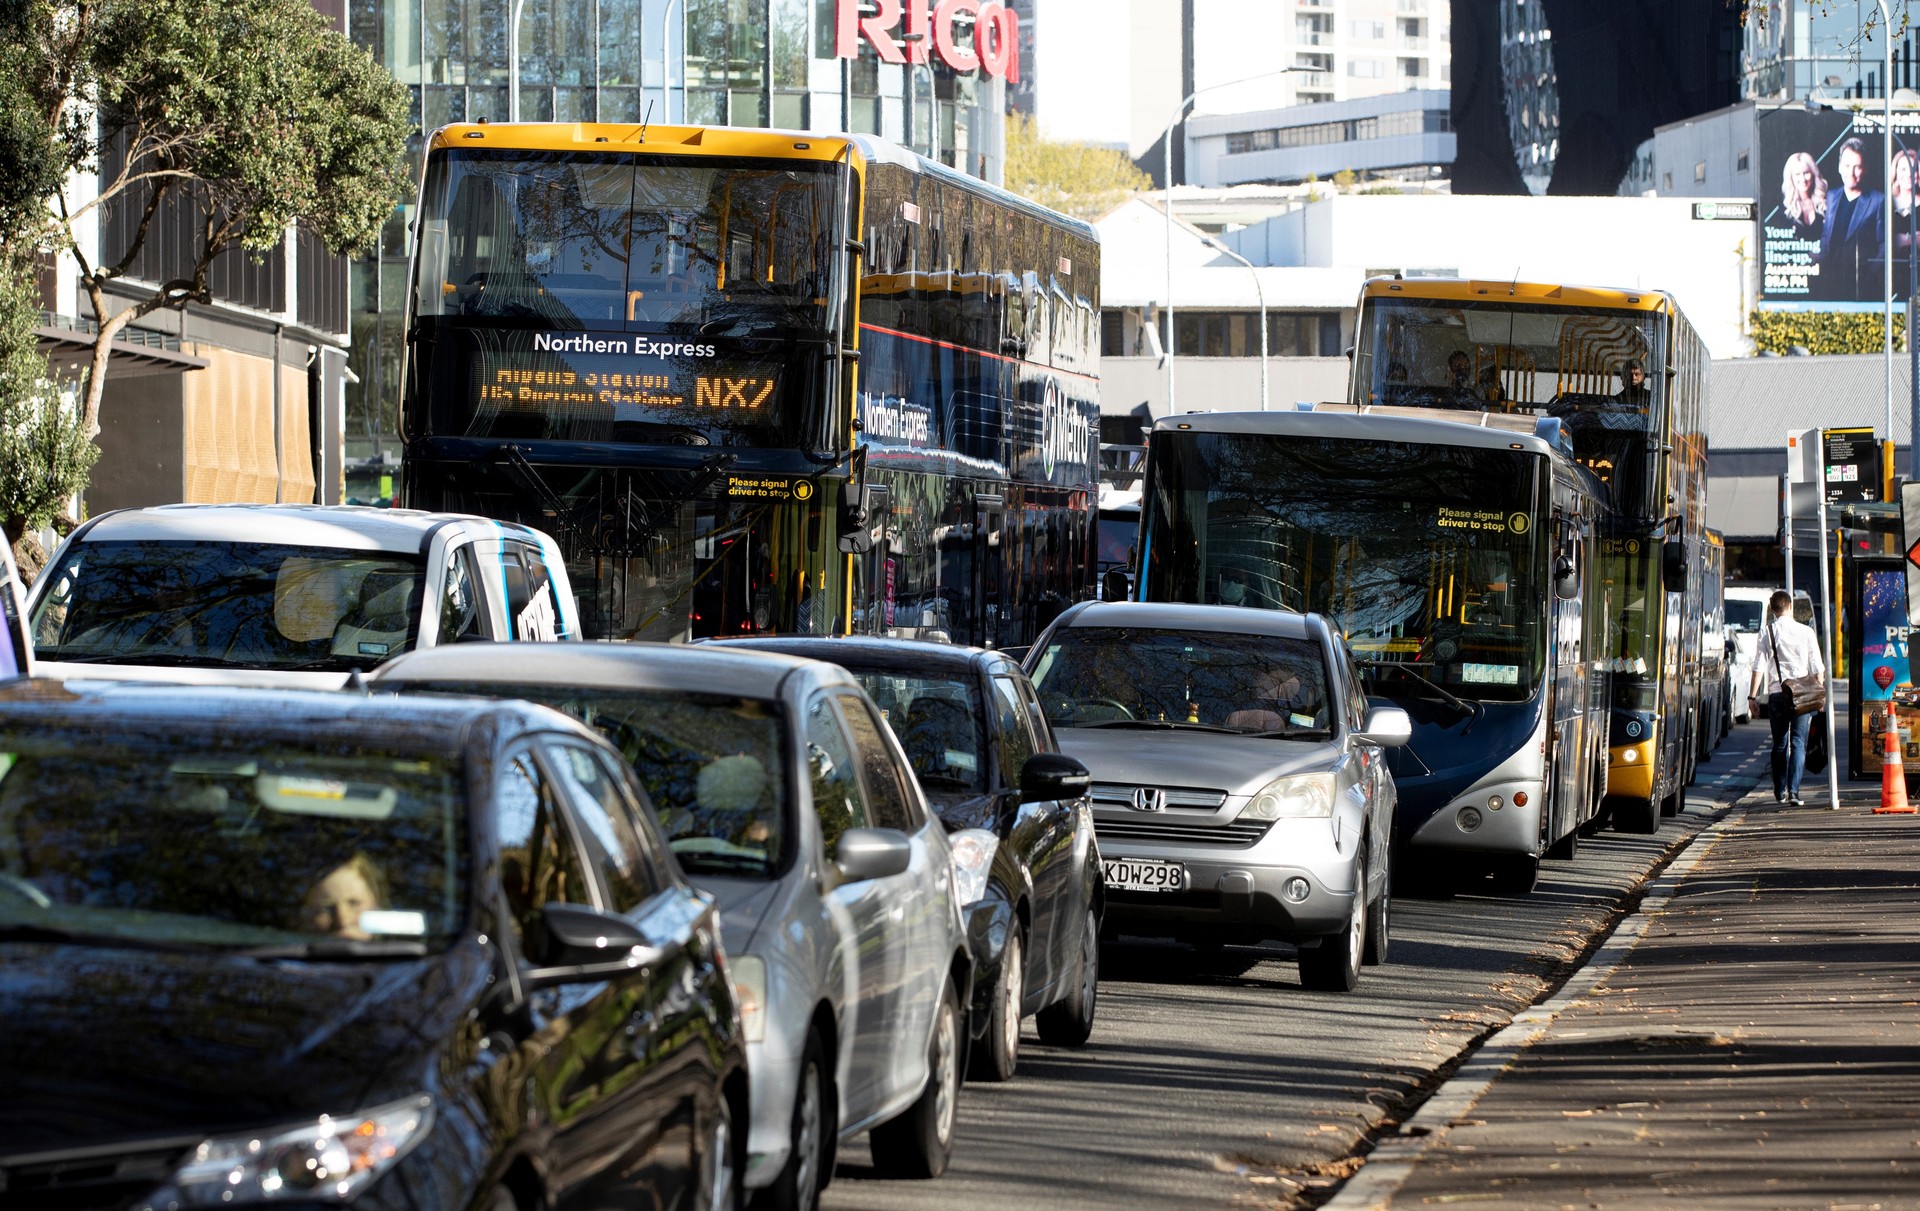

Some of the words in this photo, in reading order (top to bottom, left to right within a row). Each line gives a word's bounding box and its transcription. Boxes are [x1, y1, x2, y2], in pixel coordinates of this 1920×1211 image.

[1878, 126, 1905, 134] W'RE
[1764, 226, 1795, 239] Your
[1764, 238, 1821, 254] morning
[1764, 250, 1812, 266] line-up.
[1764, 263, 1820, 276] Auckland
[1790, 275, 1808, 288] FM
[534, 333, 628, 354] Northern
[634, 336, 716, 360] Express
[864, 391, 899, 438] Northern
[900, 397, 928, 450] Express
[1057, 389, 1089, 466] Metro
[729, 477, 759, 487] Please
[760, 479, 788, 489] signal
[728, 487, 757, 496] driver
[758, 489, 768, 497] to
[769, 490, 790, 499] stop
[1438, 507, 1471, 518] Please
[1473, 510, 1503, 522] signal
[1437, 517, 1468, 528] driver
[1470, 520, 1481, 529] to
[1482, 521, 1505, 532] stop
[1104, 862, 1180, 886] KDW298
